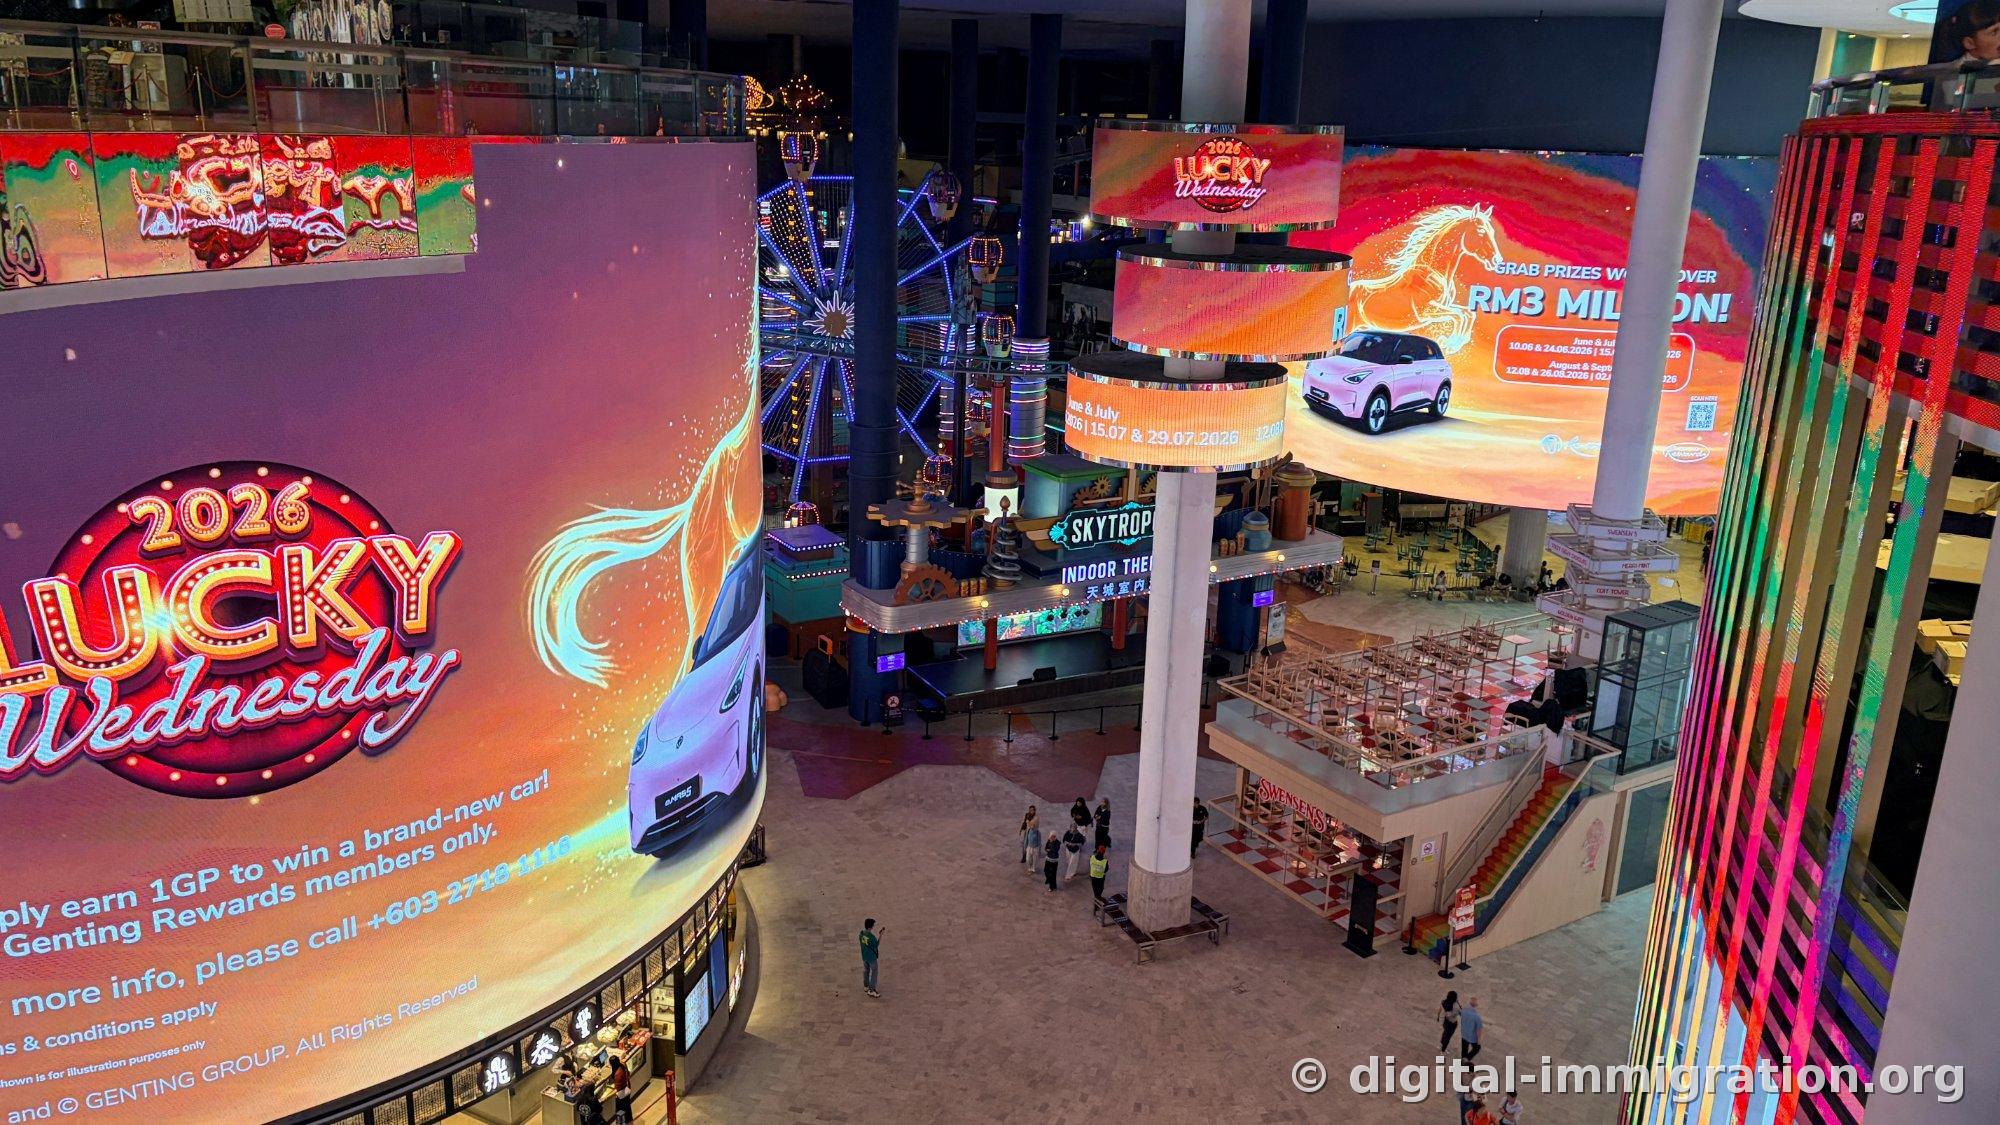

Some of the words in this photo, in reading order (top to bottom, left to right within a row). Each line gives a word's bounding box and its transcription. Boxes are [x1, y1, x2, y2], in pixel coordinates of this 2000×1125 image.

[1206, 141, 1242, 155] 2026
[1174, 155, 1271, 183] LUCKY
[1174, 178, 1267, 208] Wednesday
[1495, 262, 1539, 276] GRAB
[1543, 265, 1602, 280] PRIZES
[1468, 284, 1545, 317] RM3
[1535, 343, 1542, 352] &
[1543, 344, 1593, 355] 24.06.2026
[1573, 337, 1595, 346] June
[1595, 338, 1602, 346] &
[1531, 368, 1539, 377] &
[1549, 360, 1582, 371] August
[1582, 362, 1590, 371] &
[1085, 401, 1093, 416] &
[1094, 404, 1120, 423] July
[1091, 421, 1127, 440] 15.07
[1131, 428, 1143, 443] &
[1147, 430, 1239, 446] 29.07.2026
[132, 483, 312, 552] 2026
[1071, 510, 1155, 543] SKYTROP
[1061, 560, 1117, 584] INDOOR
[1123, 555, 1153, 575] THE
[0, 627, 460, 768] Wednesday
[61, 890, 138, 918] earn
[150, 867, 220, 903] 1GP
[229, 863, 264, 885] to
[272, 844, 329, 874] win
[339, 840, 355, 858] a
[364, 791, 504, 851] brand-new
[510, 768, 550, 802] car!
[4, 920, 142, 957] Genting
[152, 882, 296, 933] Rewards
[305, 842, 435, 896] members
[442, 821, 498, 854] only.
[11, 985, 101, 1016] more
[111, 967, 185, 999] info,
[196, 937, 299, 986] please
[308, 915, 358, 949] call
[367, 889, 439, 929] +603
[447, 862, 510, 905] 2718
[23, 1036, 41, 1052] &
[45, 1016, 155, 1047] conditions
[161, 1000, 218, 1026] apply
[8, 1101, 51, 1124] and
[57, 1097, 79, 1114] ©
[86, 1071, 195, 1109] GENTING
[202, 1044, 289, 1082] GROUP.
[295, 1031, 326, 1056] All
[331, 1013, 392, 1043] Rights
[398, 975, 478, 1020] Reserved
[36, 1074, 46, 1083] is
[48, 1070, 64, 1080] for
[67, 1059, 127, 1077] illustration
[129, 1047, 180, 1067] purposes
[182, 1039, 206, 1053] only
